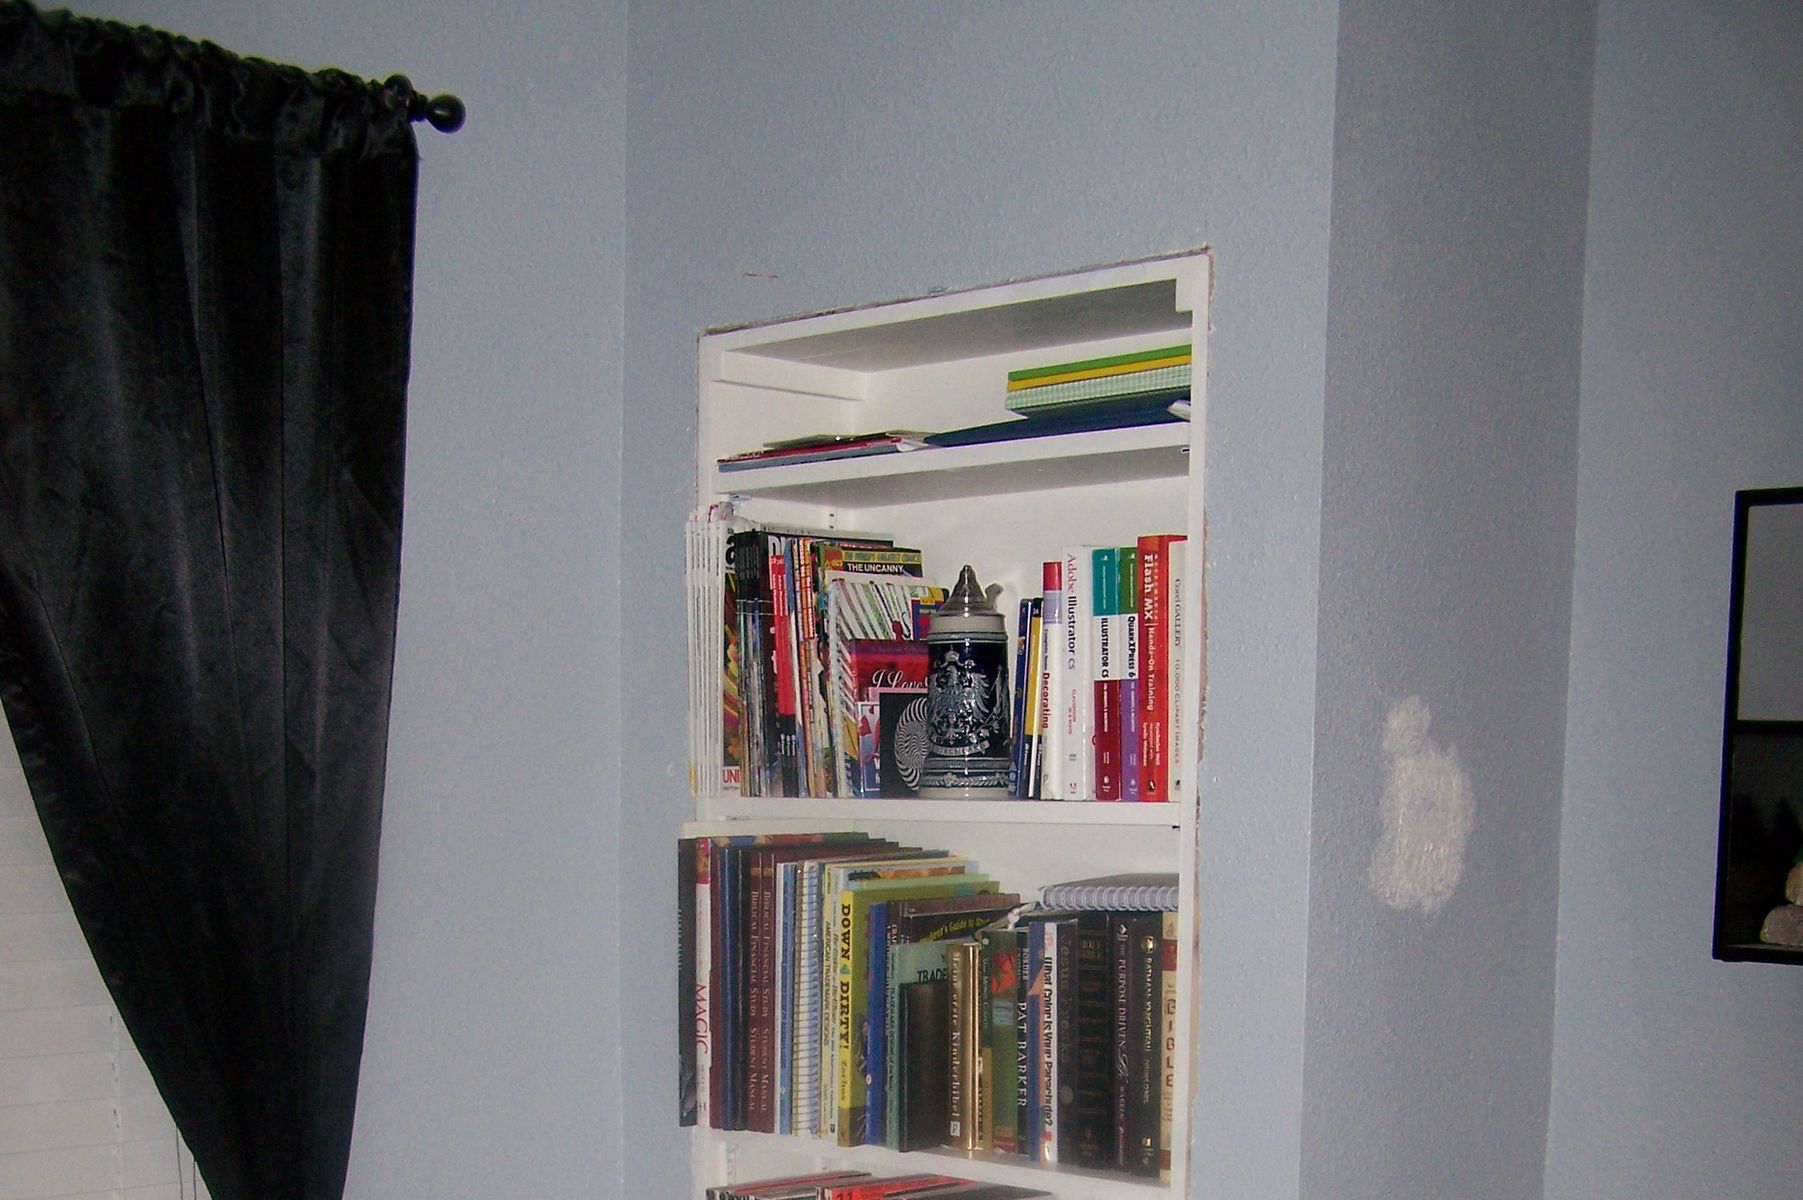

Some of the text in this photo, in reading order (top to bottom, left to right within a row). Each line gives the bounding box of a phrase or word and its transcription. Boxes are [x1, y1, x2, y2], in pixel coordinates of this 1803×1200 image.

[847, 562, 903, 573] THE UNCANNY
[1067, 553, 1078, 594] Adobe
[1143, 553, 1154, 621] Flash MX
[1067, 595, 1078, 656] Illustrator
[1100, 617, 1110, 679] ILLUSTRATOR CS
[1146, 626, 1157, 712] Hands-On Training
[1041, 672, 1051, 729] Decorating
[824, 921, 832, 962] AMERICAN
[840, 903, 851, 960] DOWN
[1117, 959, 1128, 1004] PURPOSE
[695, 983, 709, 1055] MAGIC
[839, 980, 851, 1050] DIRTY!
[1117, 1007, 1128, 1048] DRIVEN
[1016, 1002, 1028, 1107] PAT BARKER
